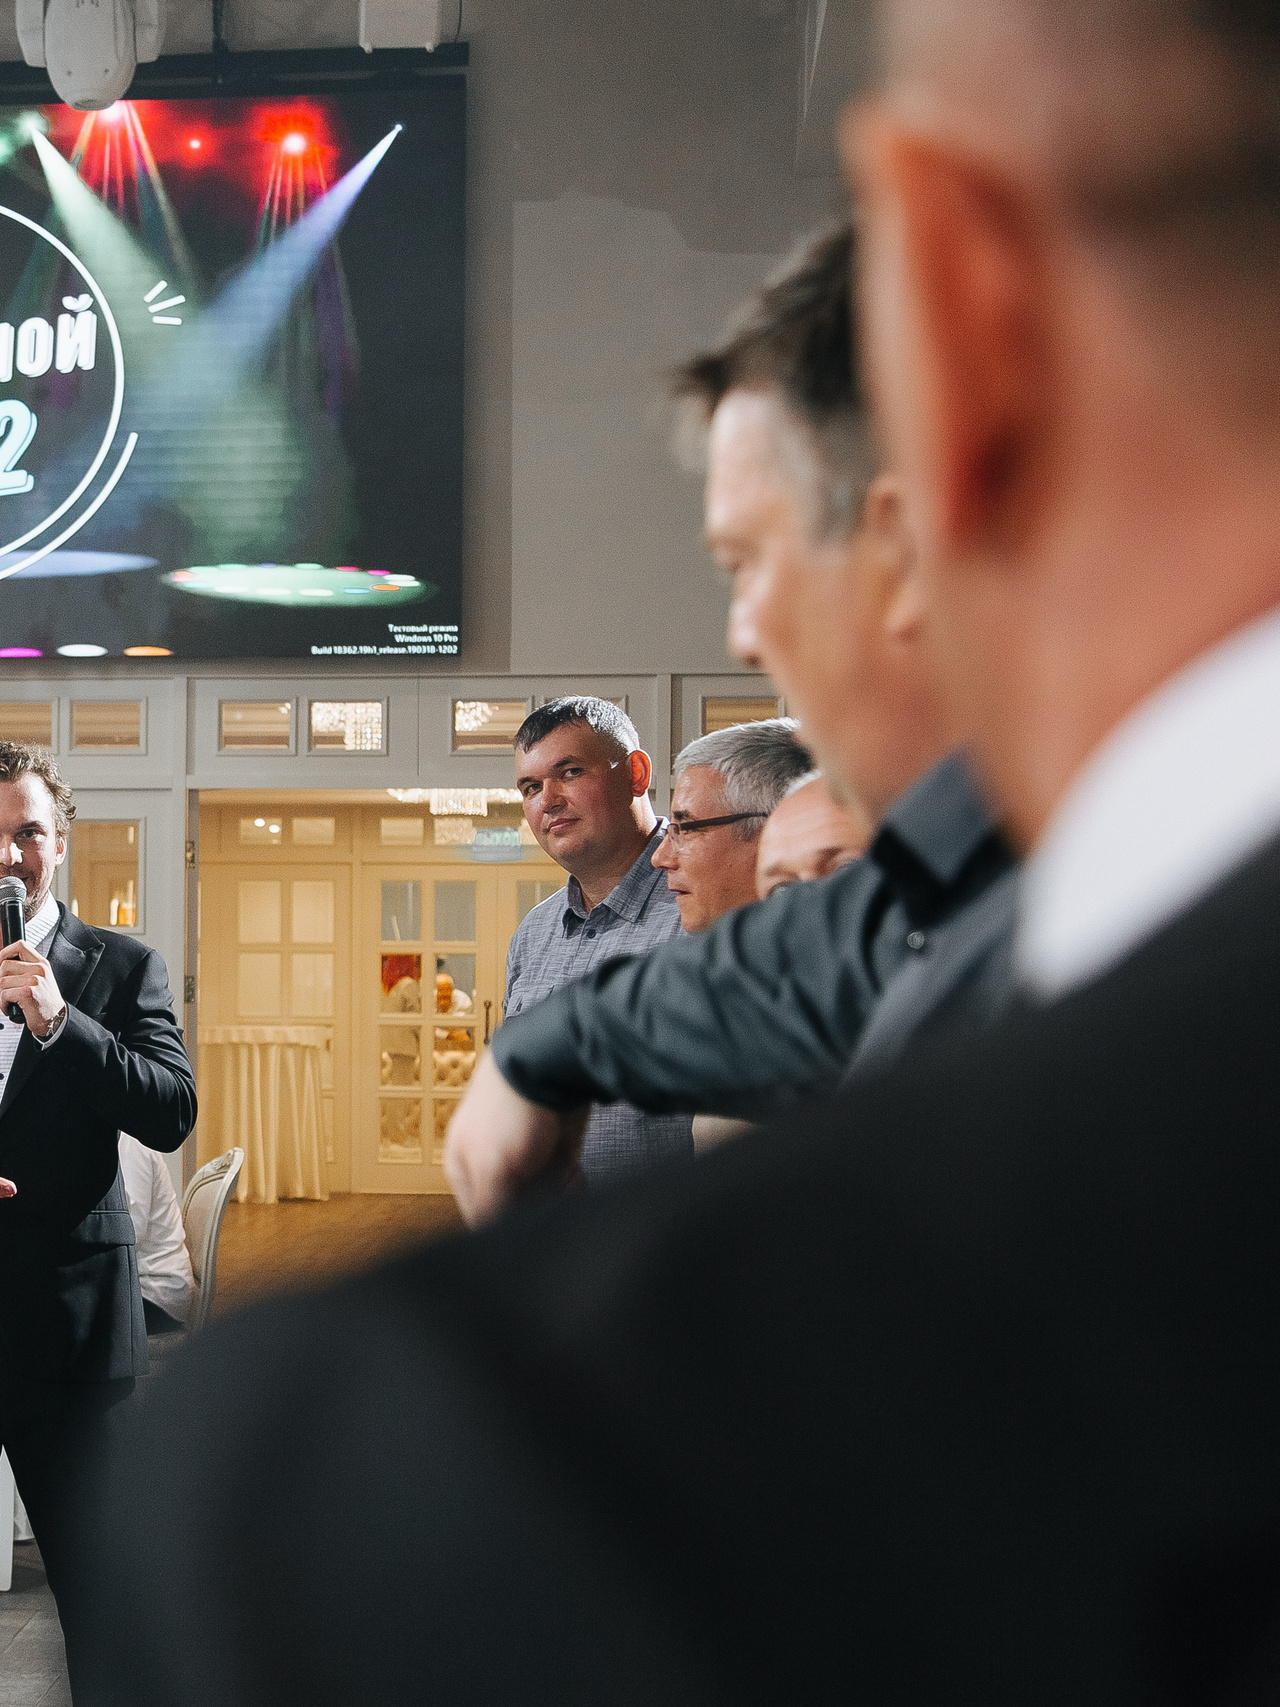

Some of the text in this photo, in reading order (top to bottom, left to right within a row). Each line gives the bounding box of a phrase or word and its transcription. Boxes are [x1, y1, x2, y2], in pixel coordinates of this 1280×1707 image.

[388, 624, 458, 633] Тестовый режим
[394, 634, 458, 642] Windows 10 Pro
[311, 646, 332, 654] Build
